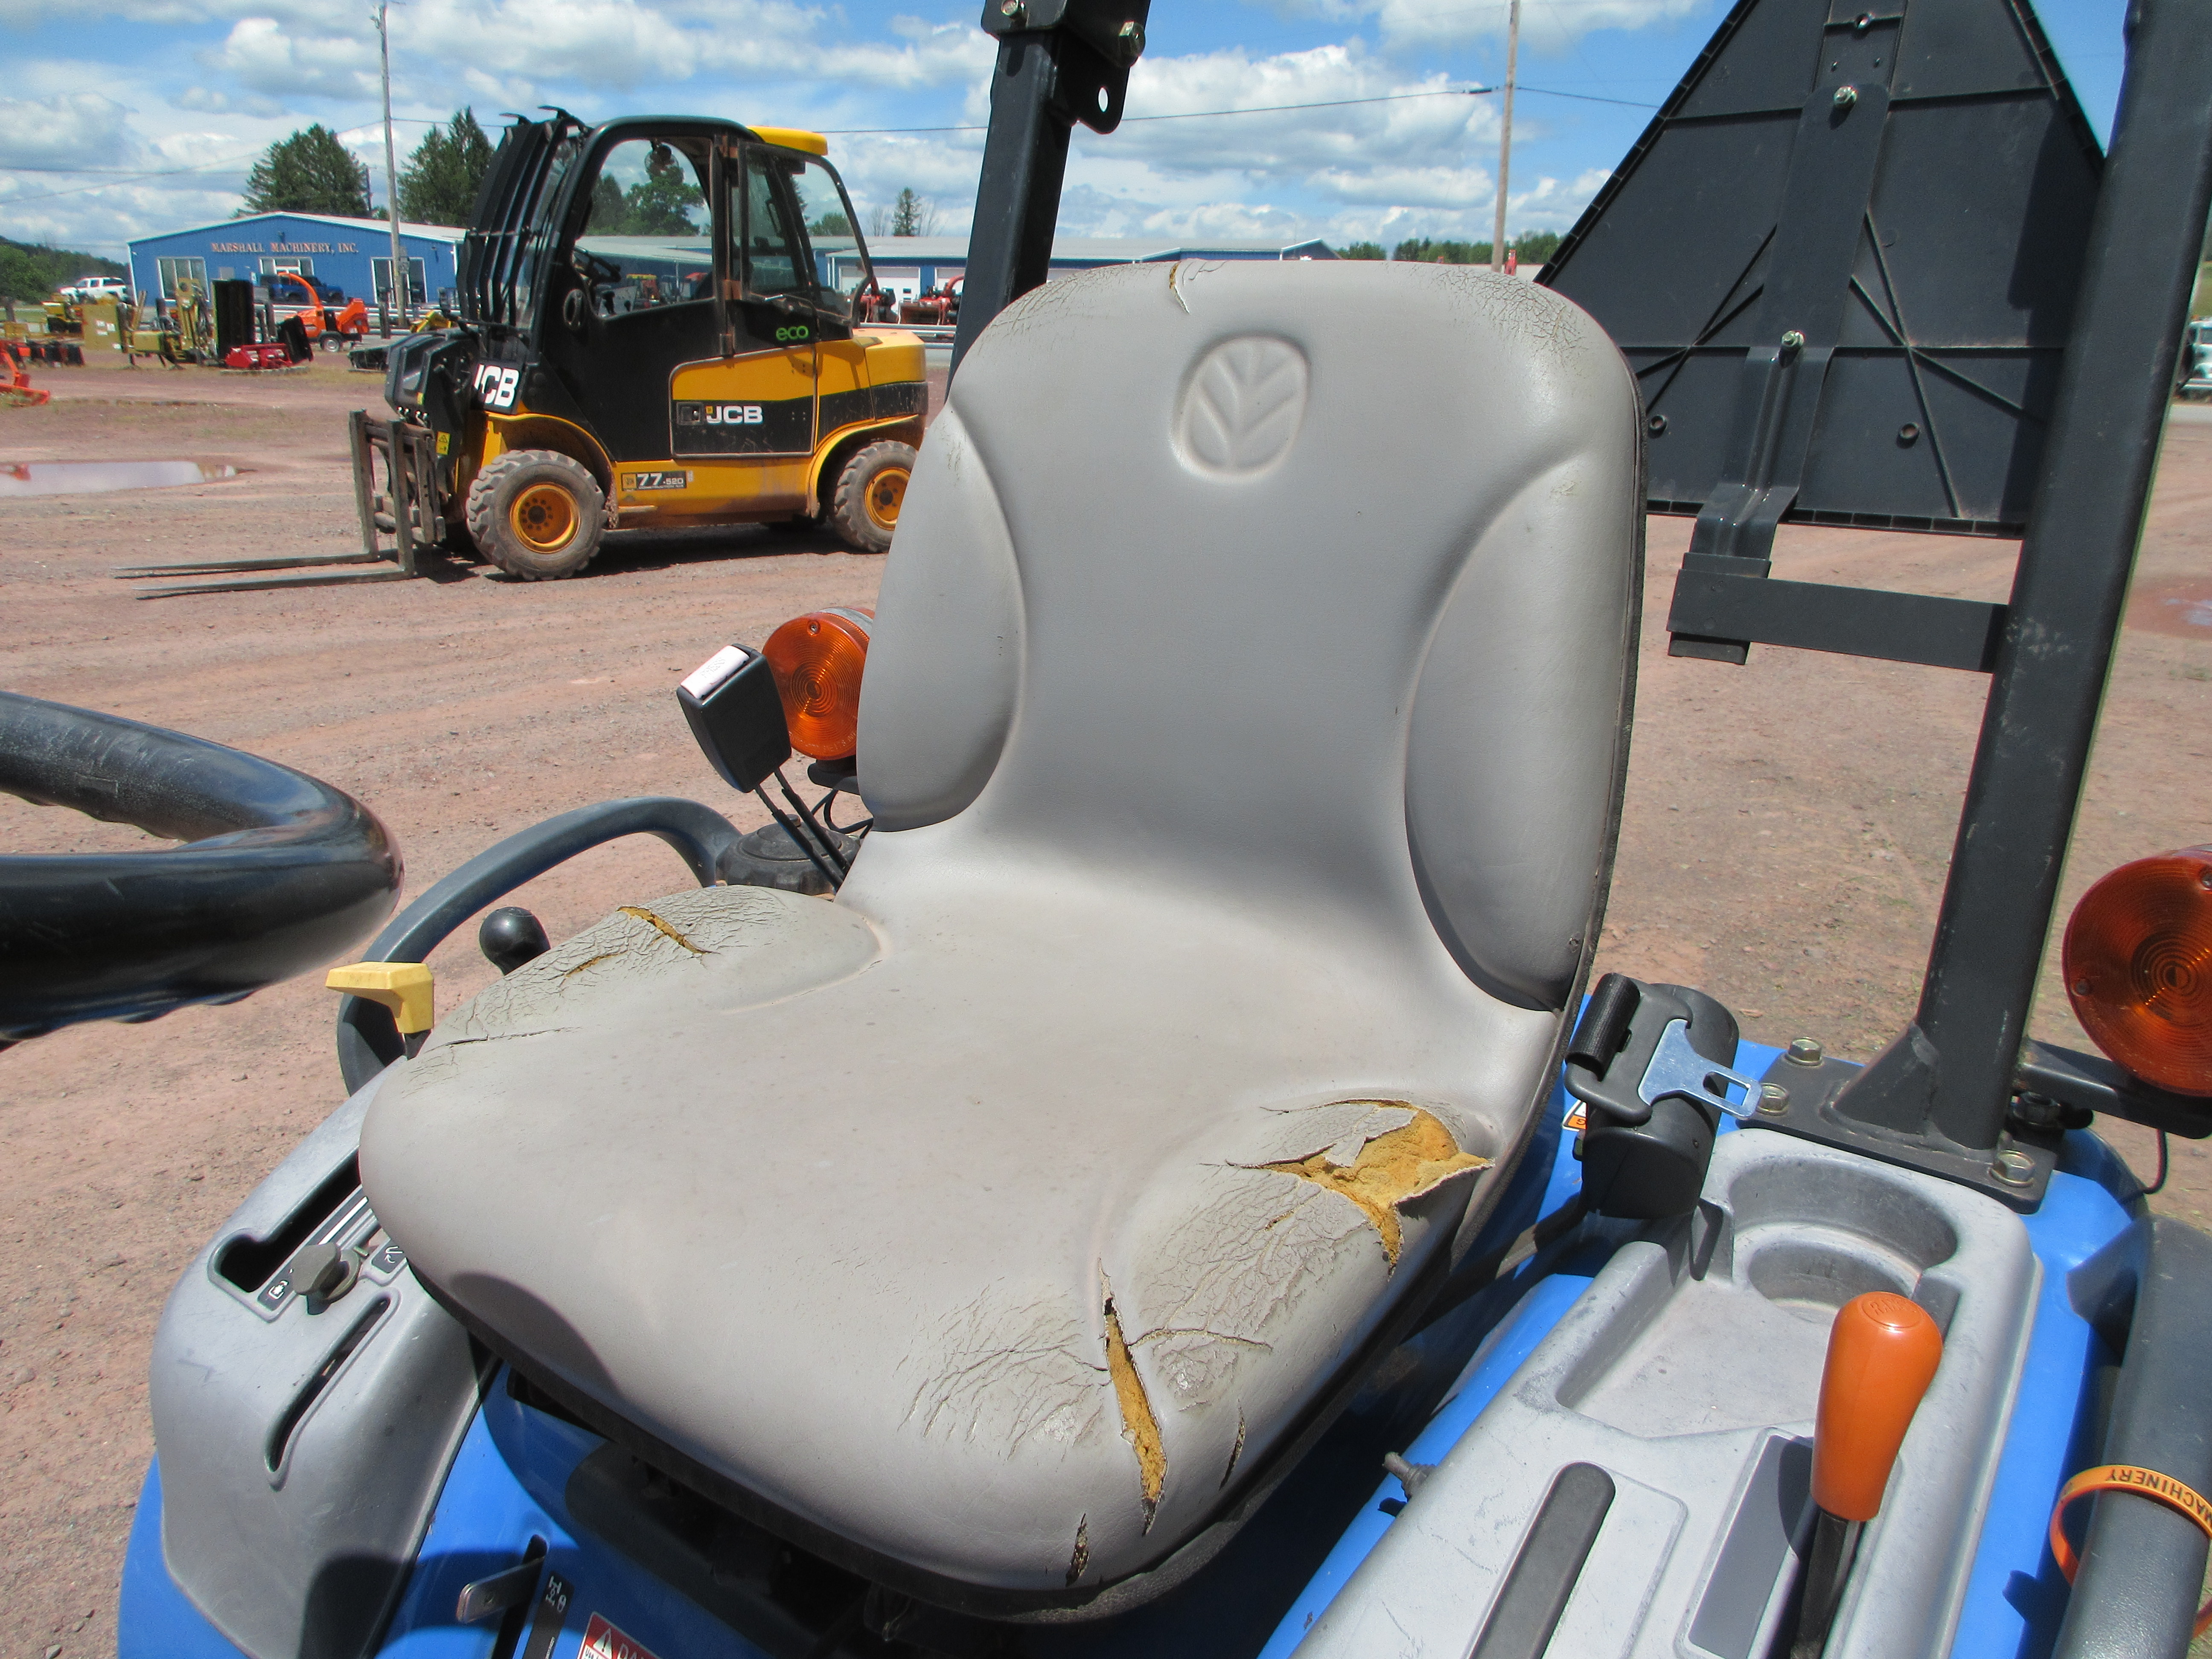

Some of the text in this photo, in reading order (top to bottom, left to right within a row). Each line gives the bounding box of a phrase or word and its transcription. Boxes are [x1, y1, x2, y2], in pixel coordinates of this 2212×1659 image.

[210, 242, 359, 254] MARSHALL MACHINERY, INC.
[776, 325, 809, 341] eco
[705, 405, 763, 425] JCB
[699, 657, 726, 678] PRESS
